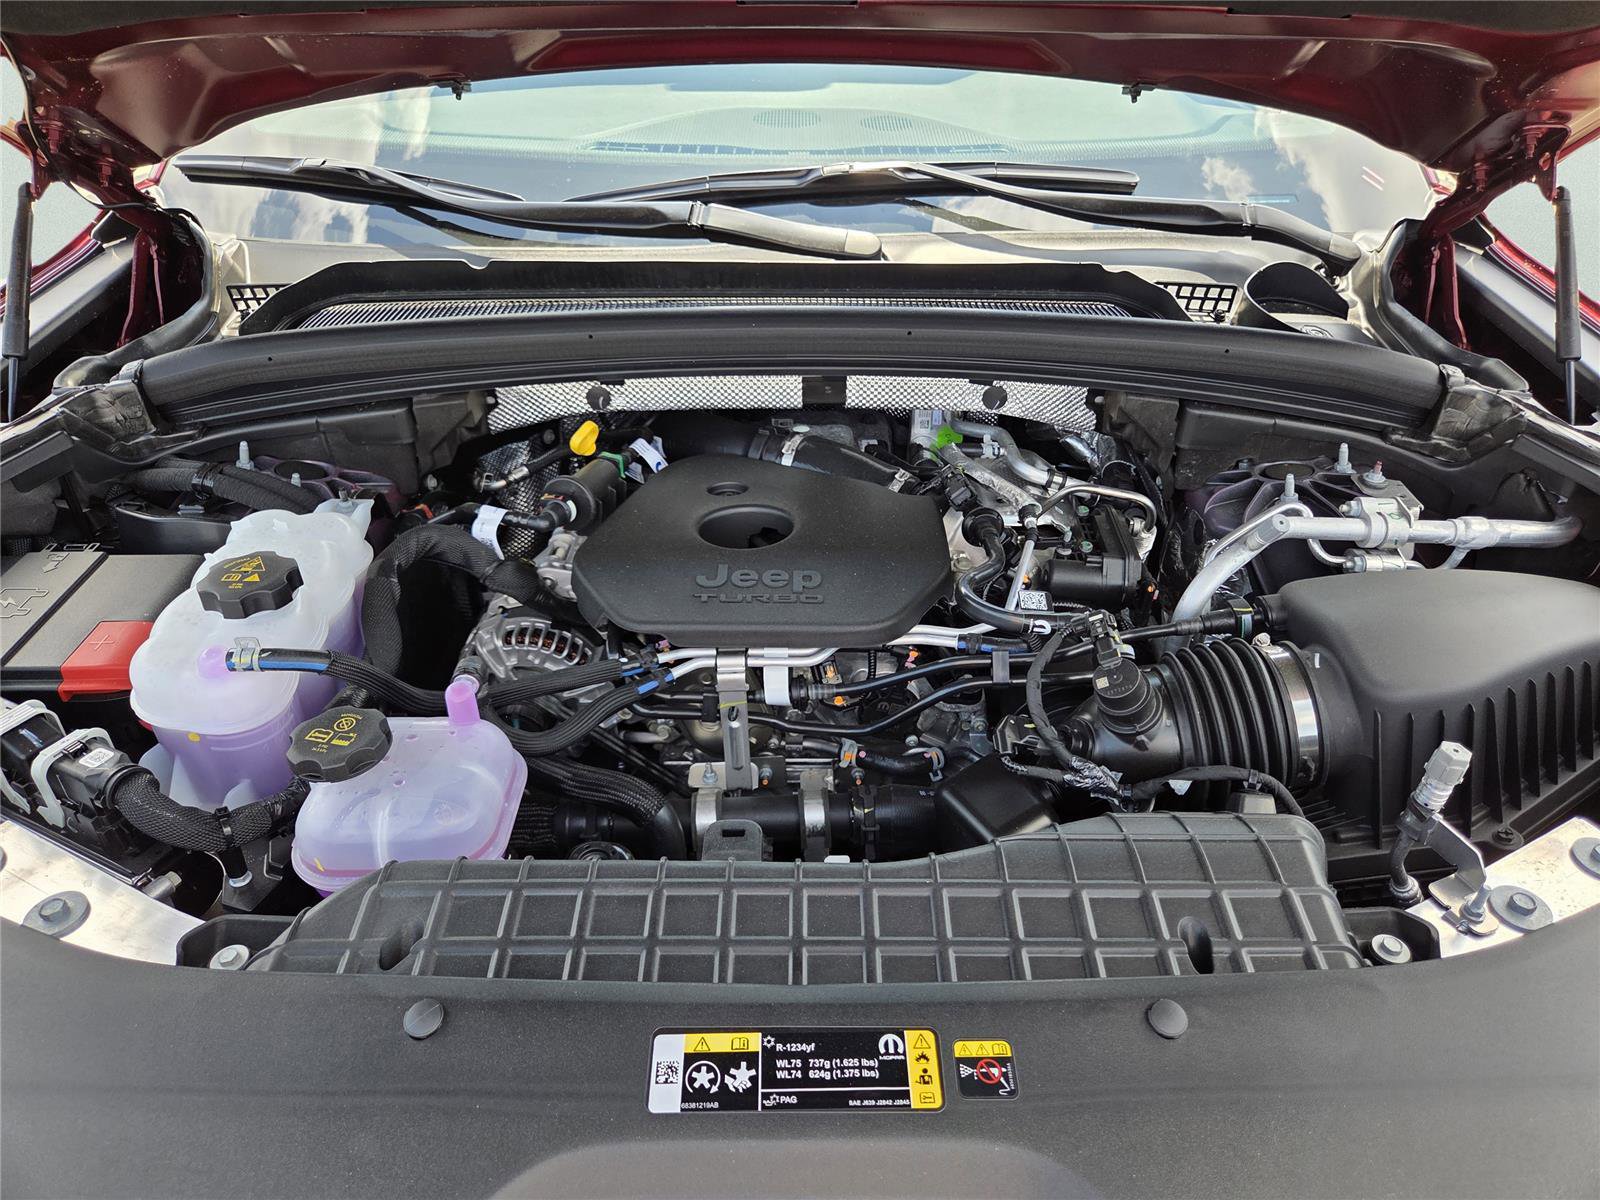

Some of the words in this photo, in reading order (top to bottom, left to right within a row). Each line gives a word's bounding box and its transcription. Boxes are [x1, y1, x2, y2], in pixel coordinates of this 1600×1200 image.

[695, 563, 822, 593] Jeep
[693, 593, 825, 604] TURBO
[776, 1043, 815, 1053] R-1234yf
[776, 1059, 802, 1068] WL75
[808, 1059, 831, 1069] 737g
[832, 1059, 860, 1068] (1.625
[861, 1058, 879, 1068] lbs)
[776, 1070, 802, 1078] WL74
[809, 1070, 831, 1080] 624g
[832, 1069, 861, 1079] (1.375
[862, 1068, 880, 1079] lbs)
[780, 1095, 798, 1104] PAG
